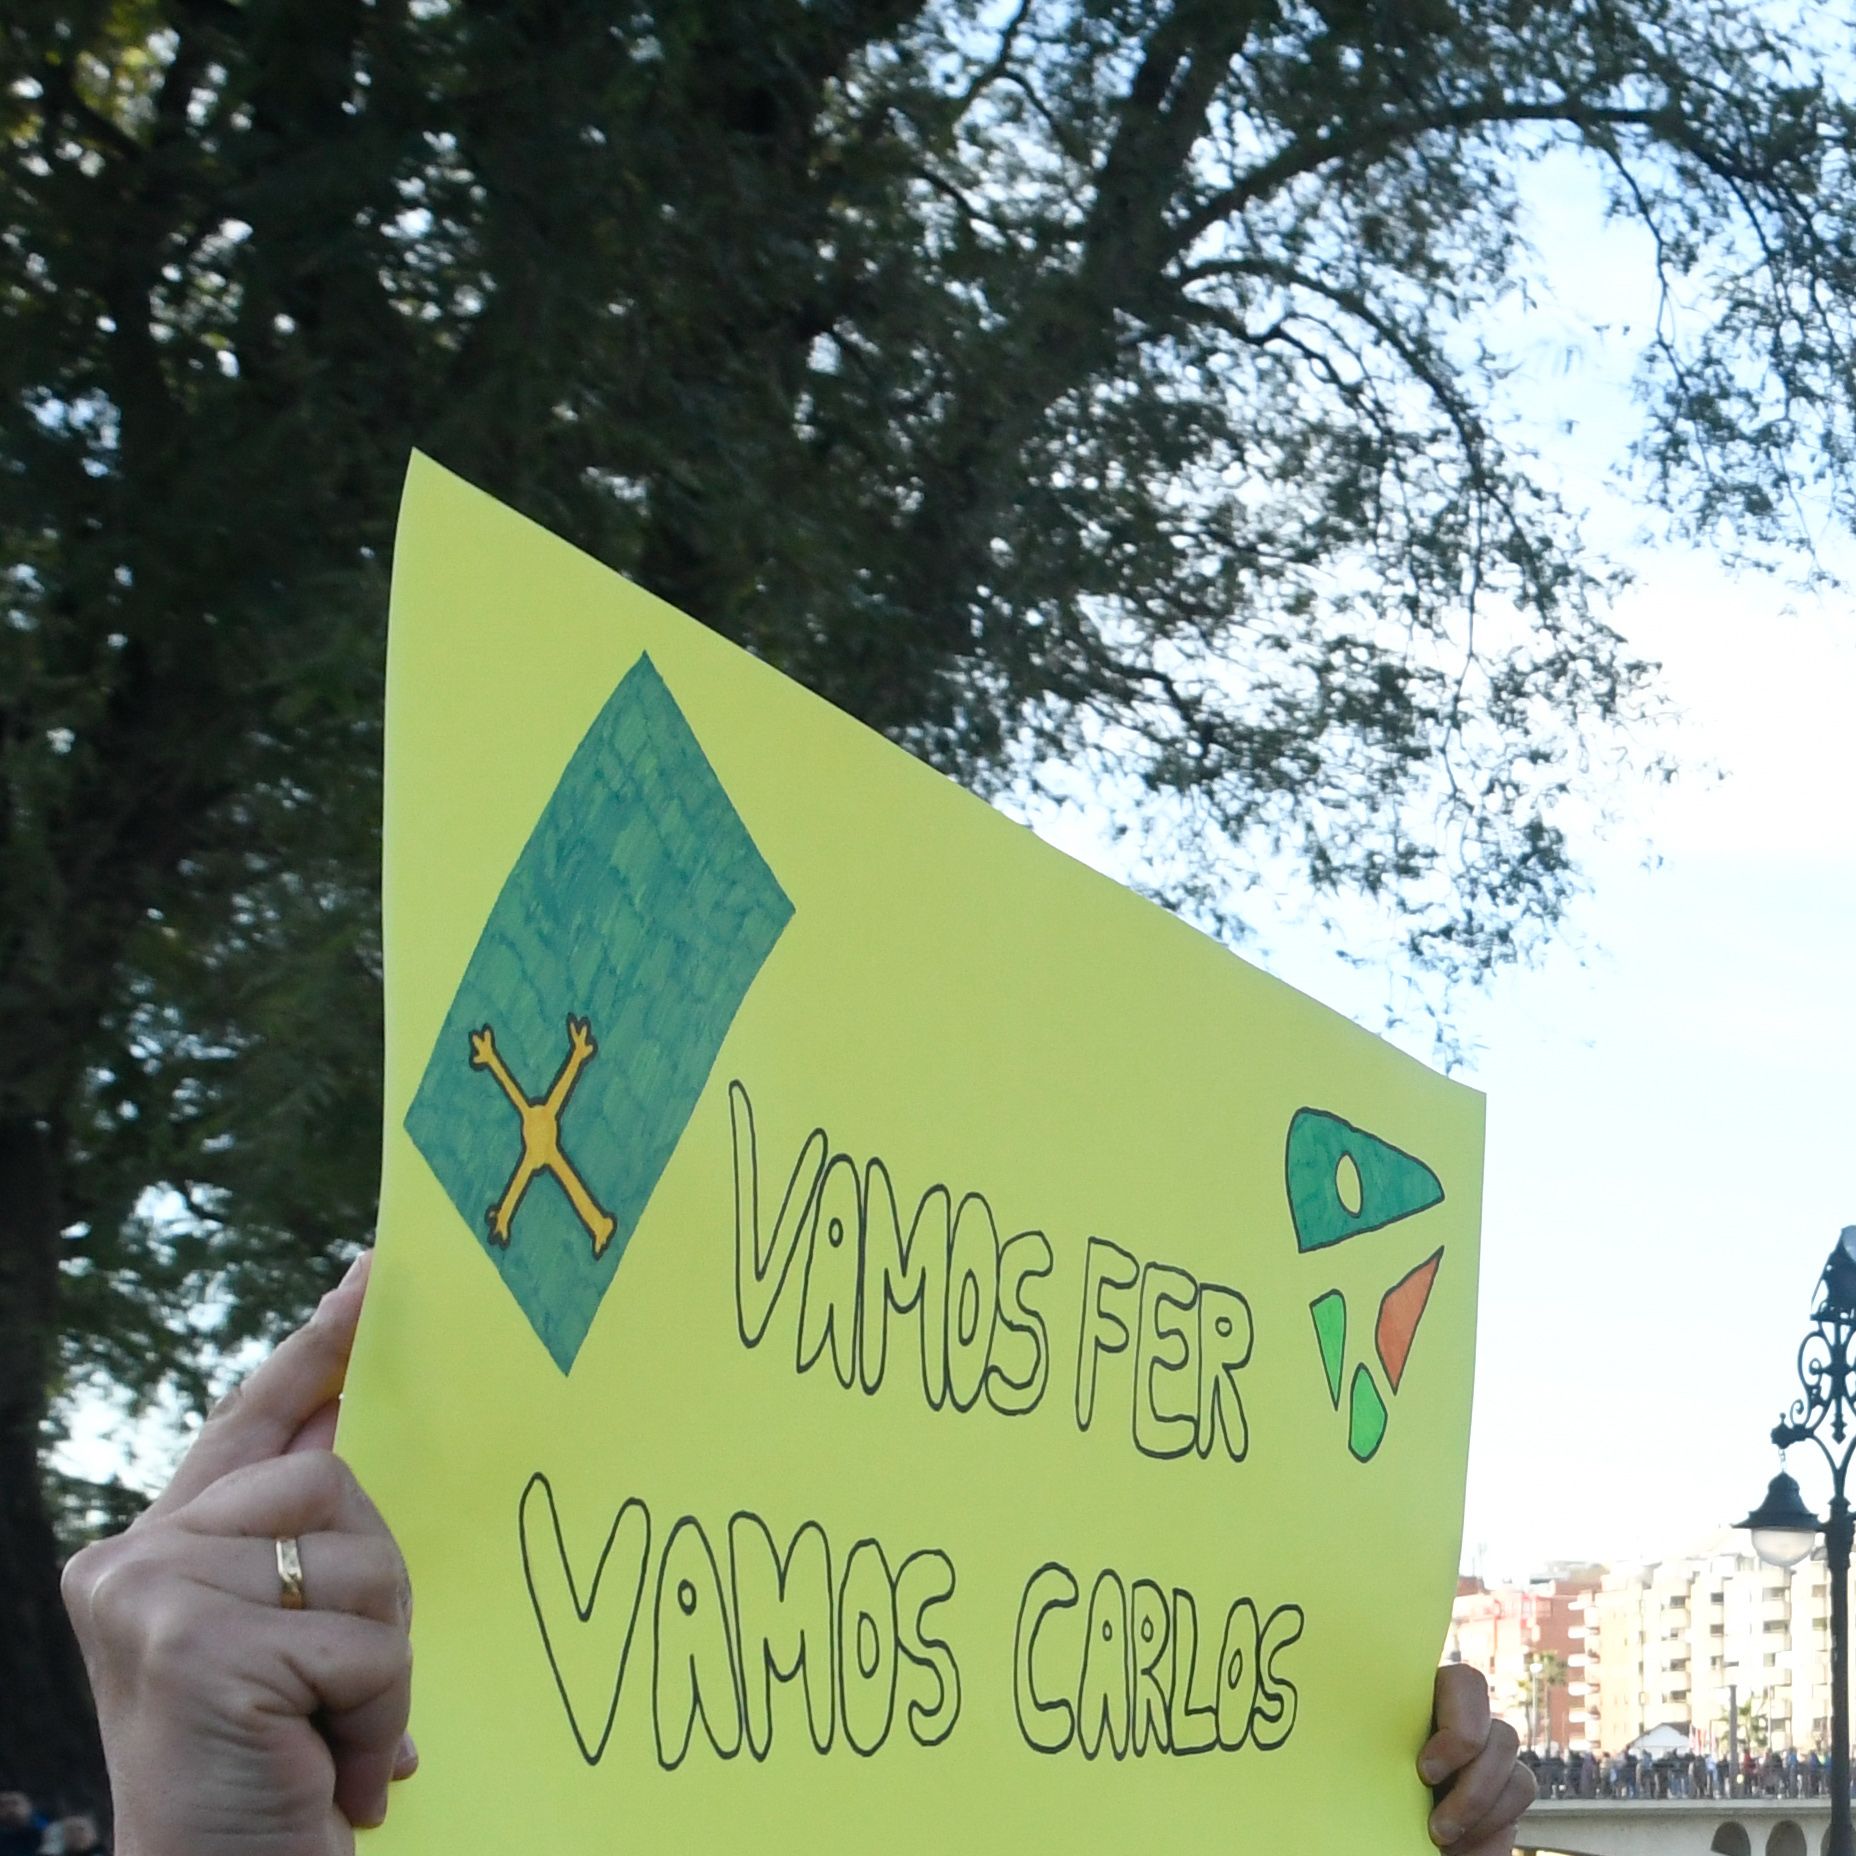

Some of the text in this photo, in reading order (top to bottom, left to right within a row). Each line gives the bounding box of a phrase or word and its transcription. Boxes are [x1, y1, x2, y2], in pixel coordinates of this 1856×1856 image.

[727, 1078, 1255, 1464] VAMOS FER
[517, 1470, 1306, 1773] VAMOS CARLOS
